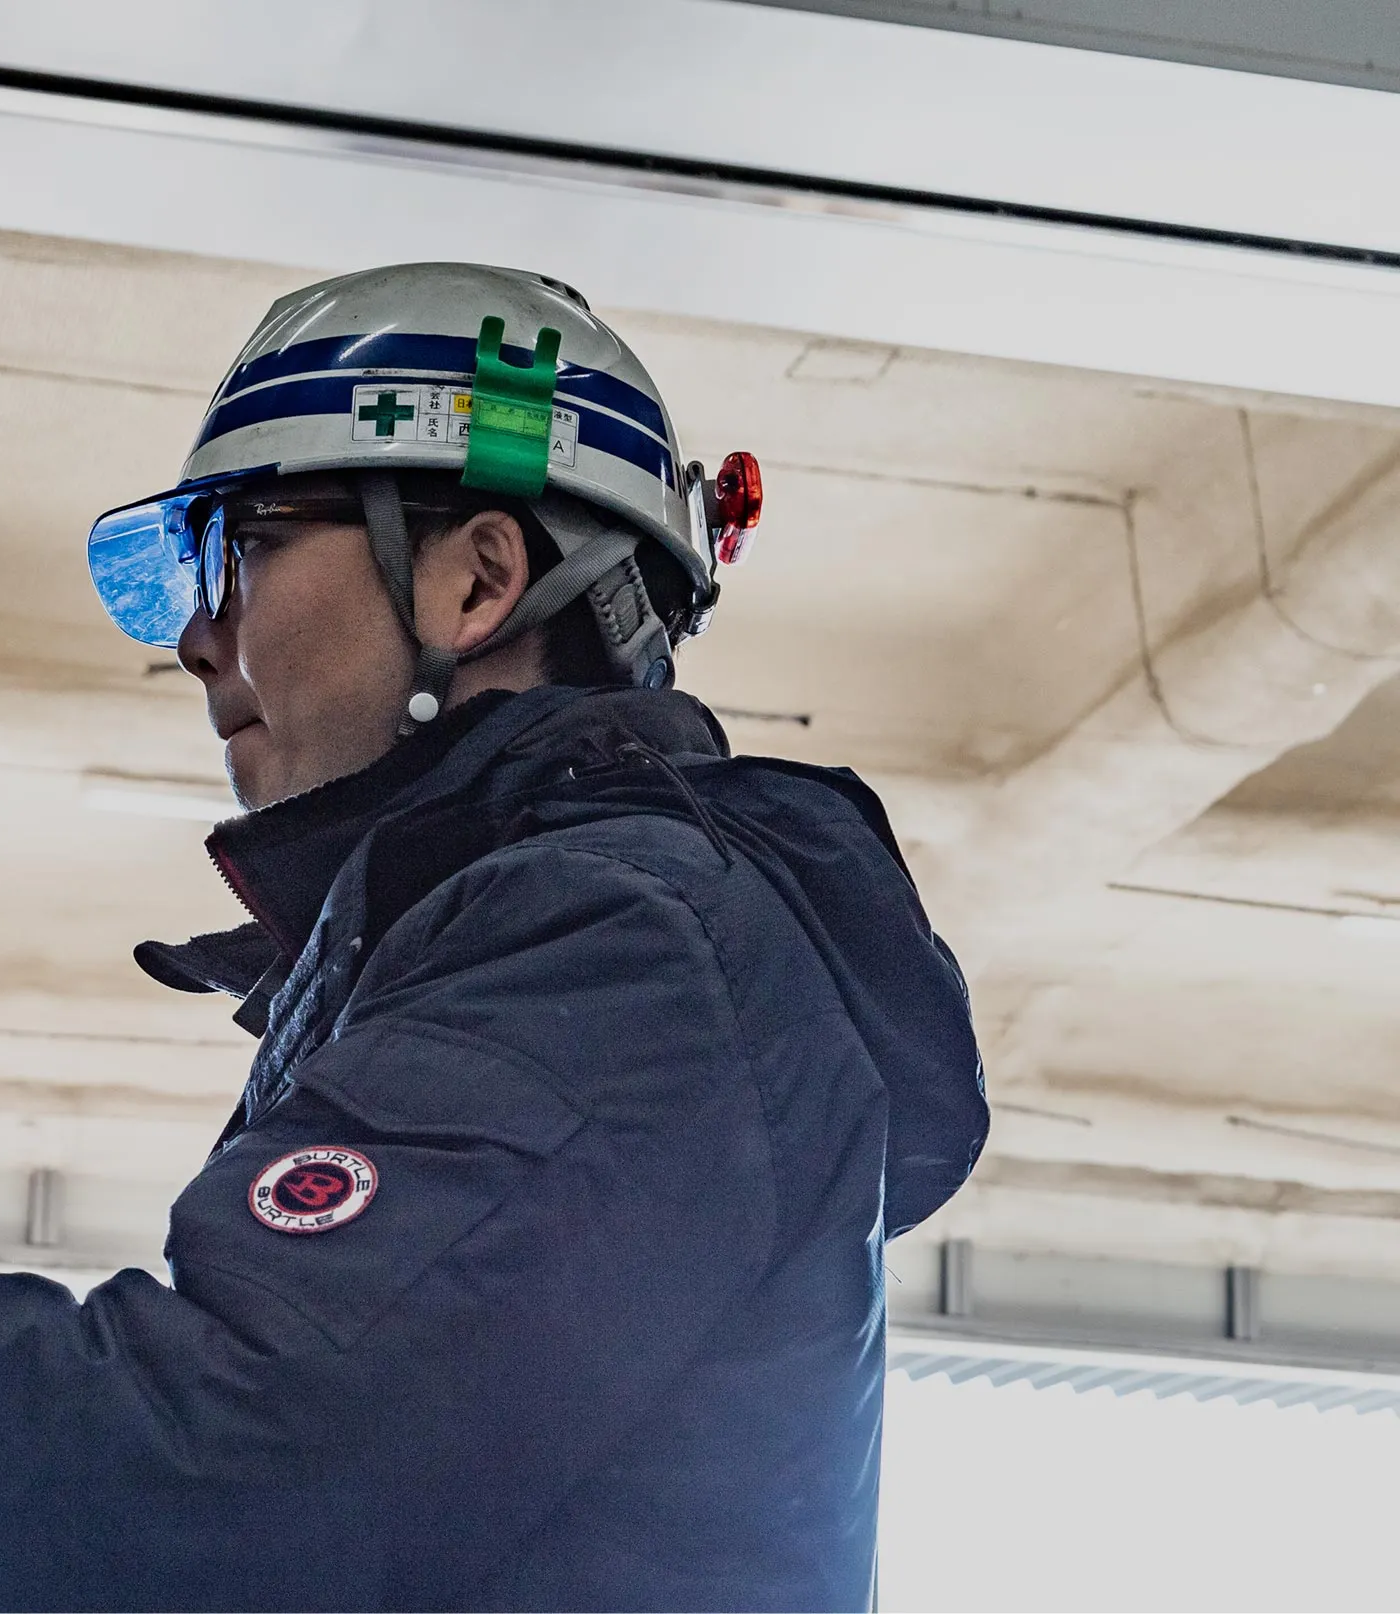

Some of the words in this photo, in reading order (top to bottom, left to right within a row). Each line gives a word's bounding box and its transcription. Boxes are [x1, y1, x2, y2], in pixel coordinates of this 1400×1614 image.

[427, 418, 439, 438] 氏名
[552, 440, 565, 453] A
[293, 1151, 371, 1193] BURTLE
[257, 1185, 334, 1227] BURTLE
